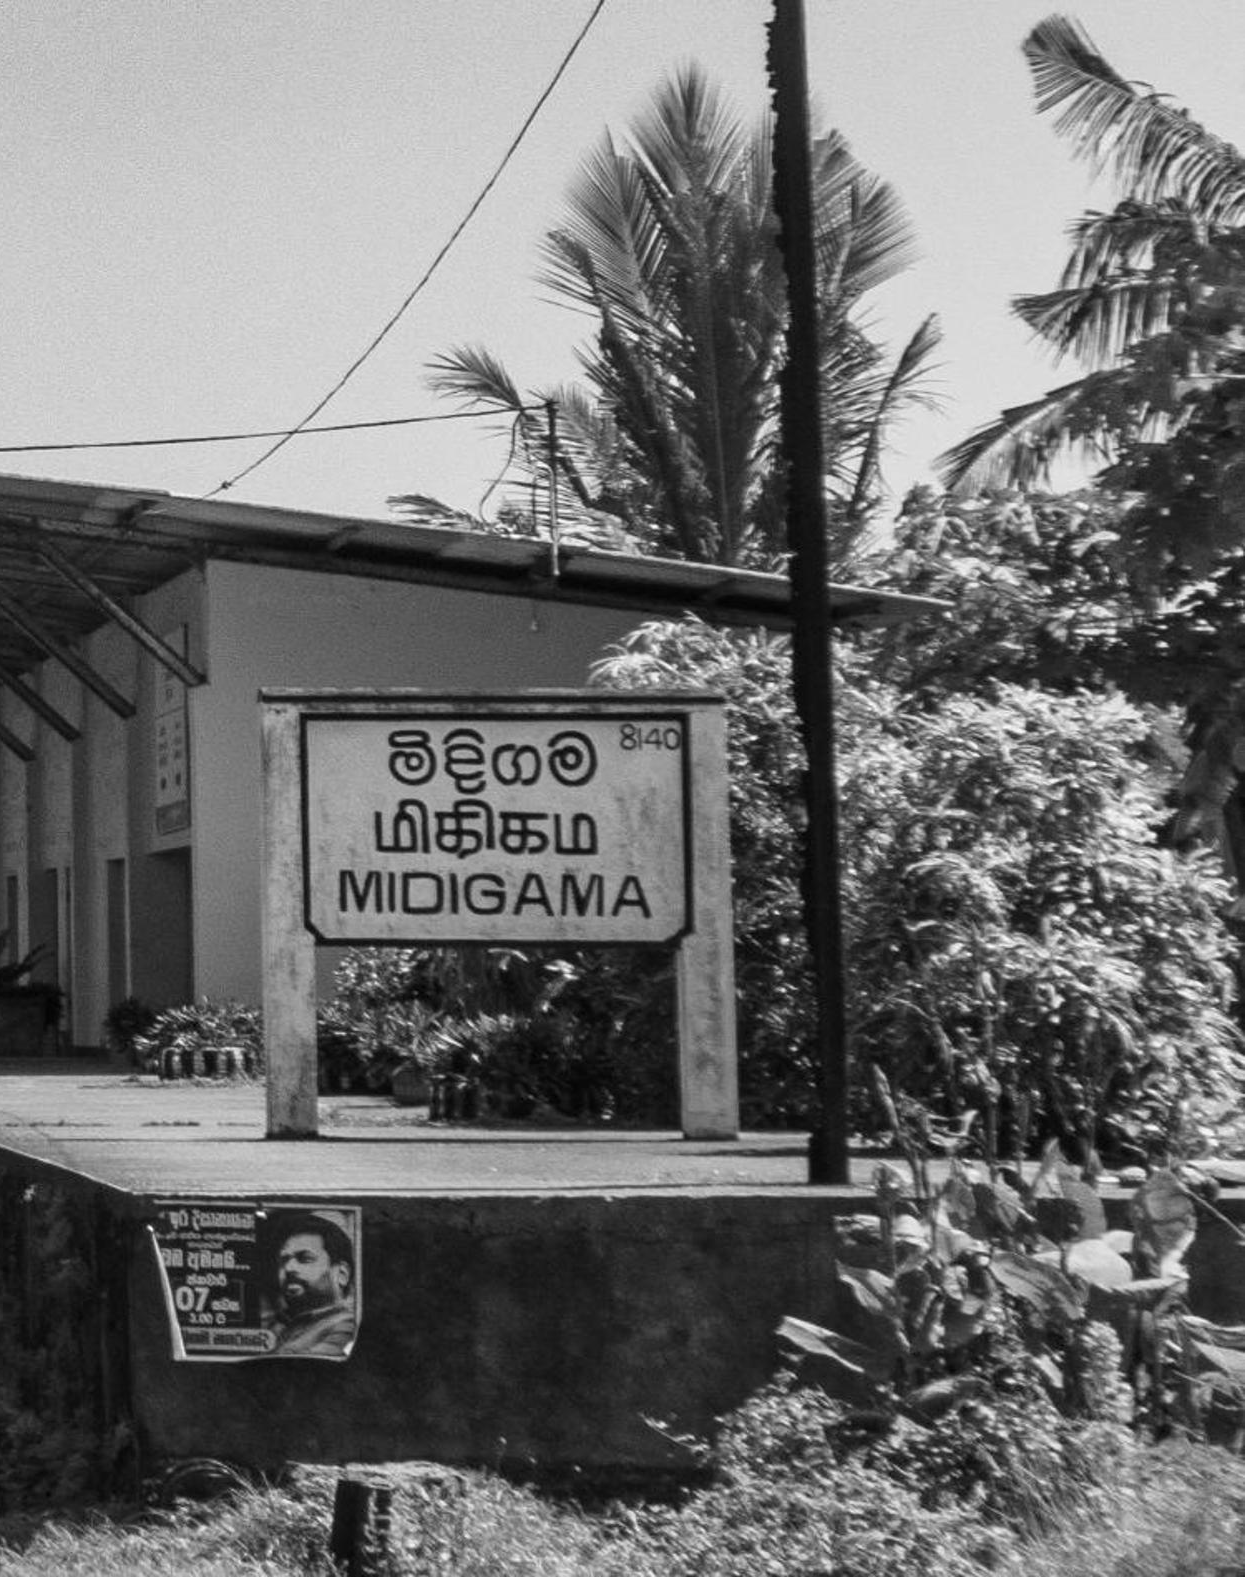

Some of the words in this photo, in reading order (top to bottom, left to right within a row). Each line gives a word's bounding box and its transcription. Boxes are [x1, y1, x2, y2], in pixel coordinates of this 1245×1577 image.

[388, 729, 597, 794] මිදිගම
[619, 723, 681, 751] 8140
[375, 799, 598, 860] மிதிகம
[339, 869, 652, 919] MIDIGAMA
[175, 1286, 210, 1312] 07
